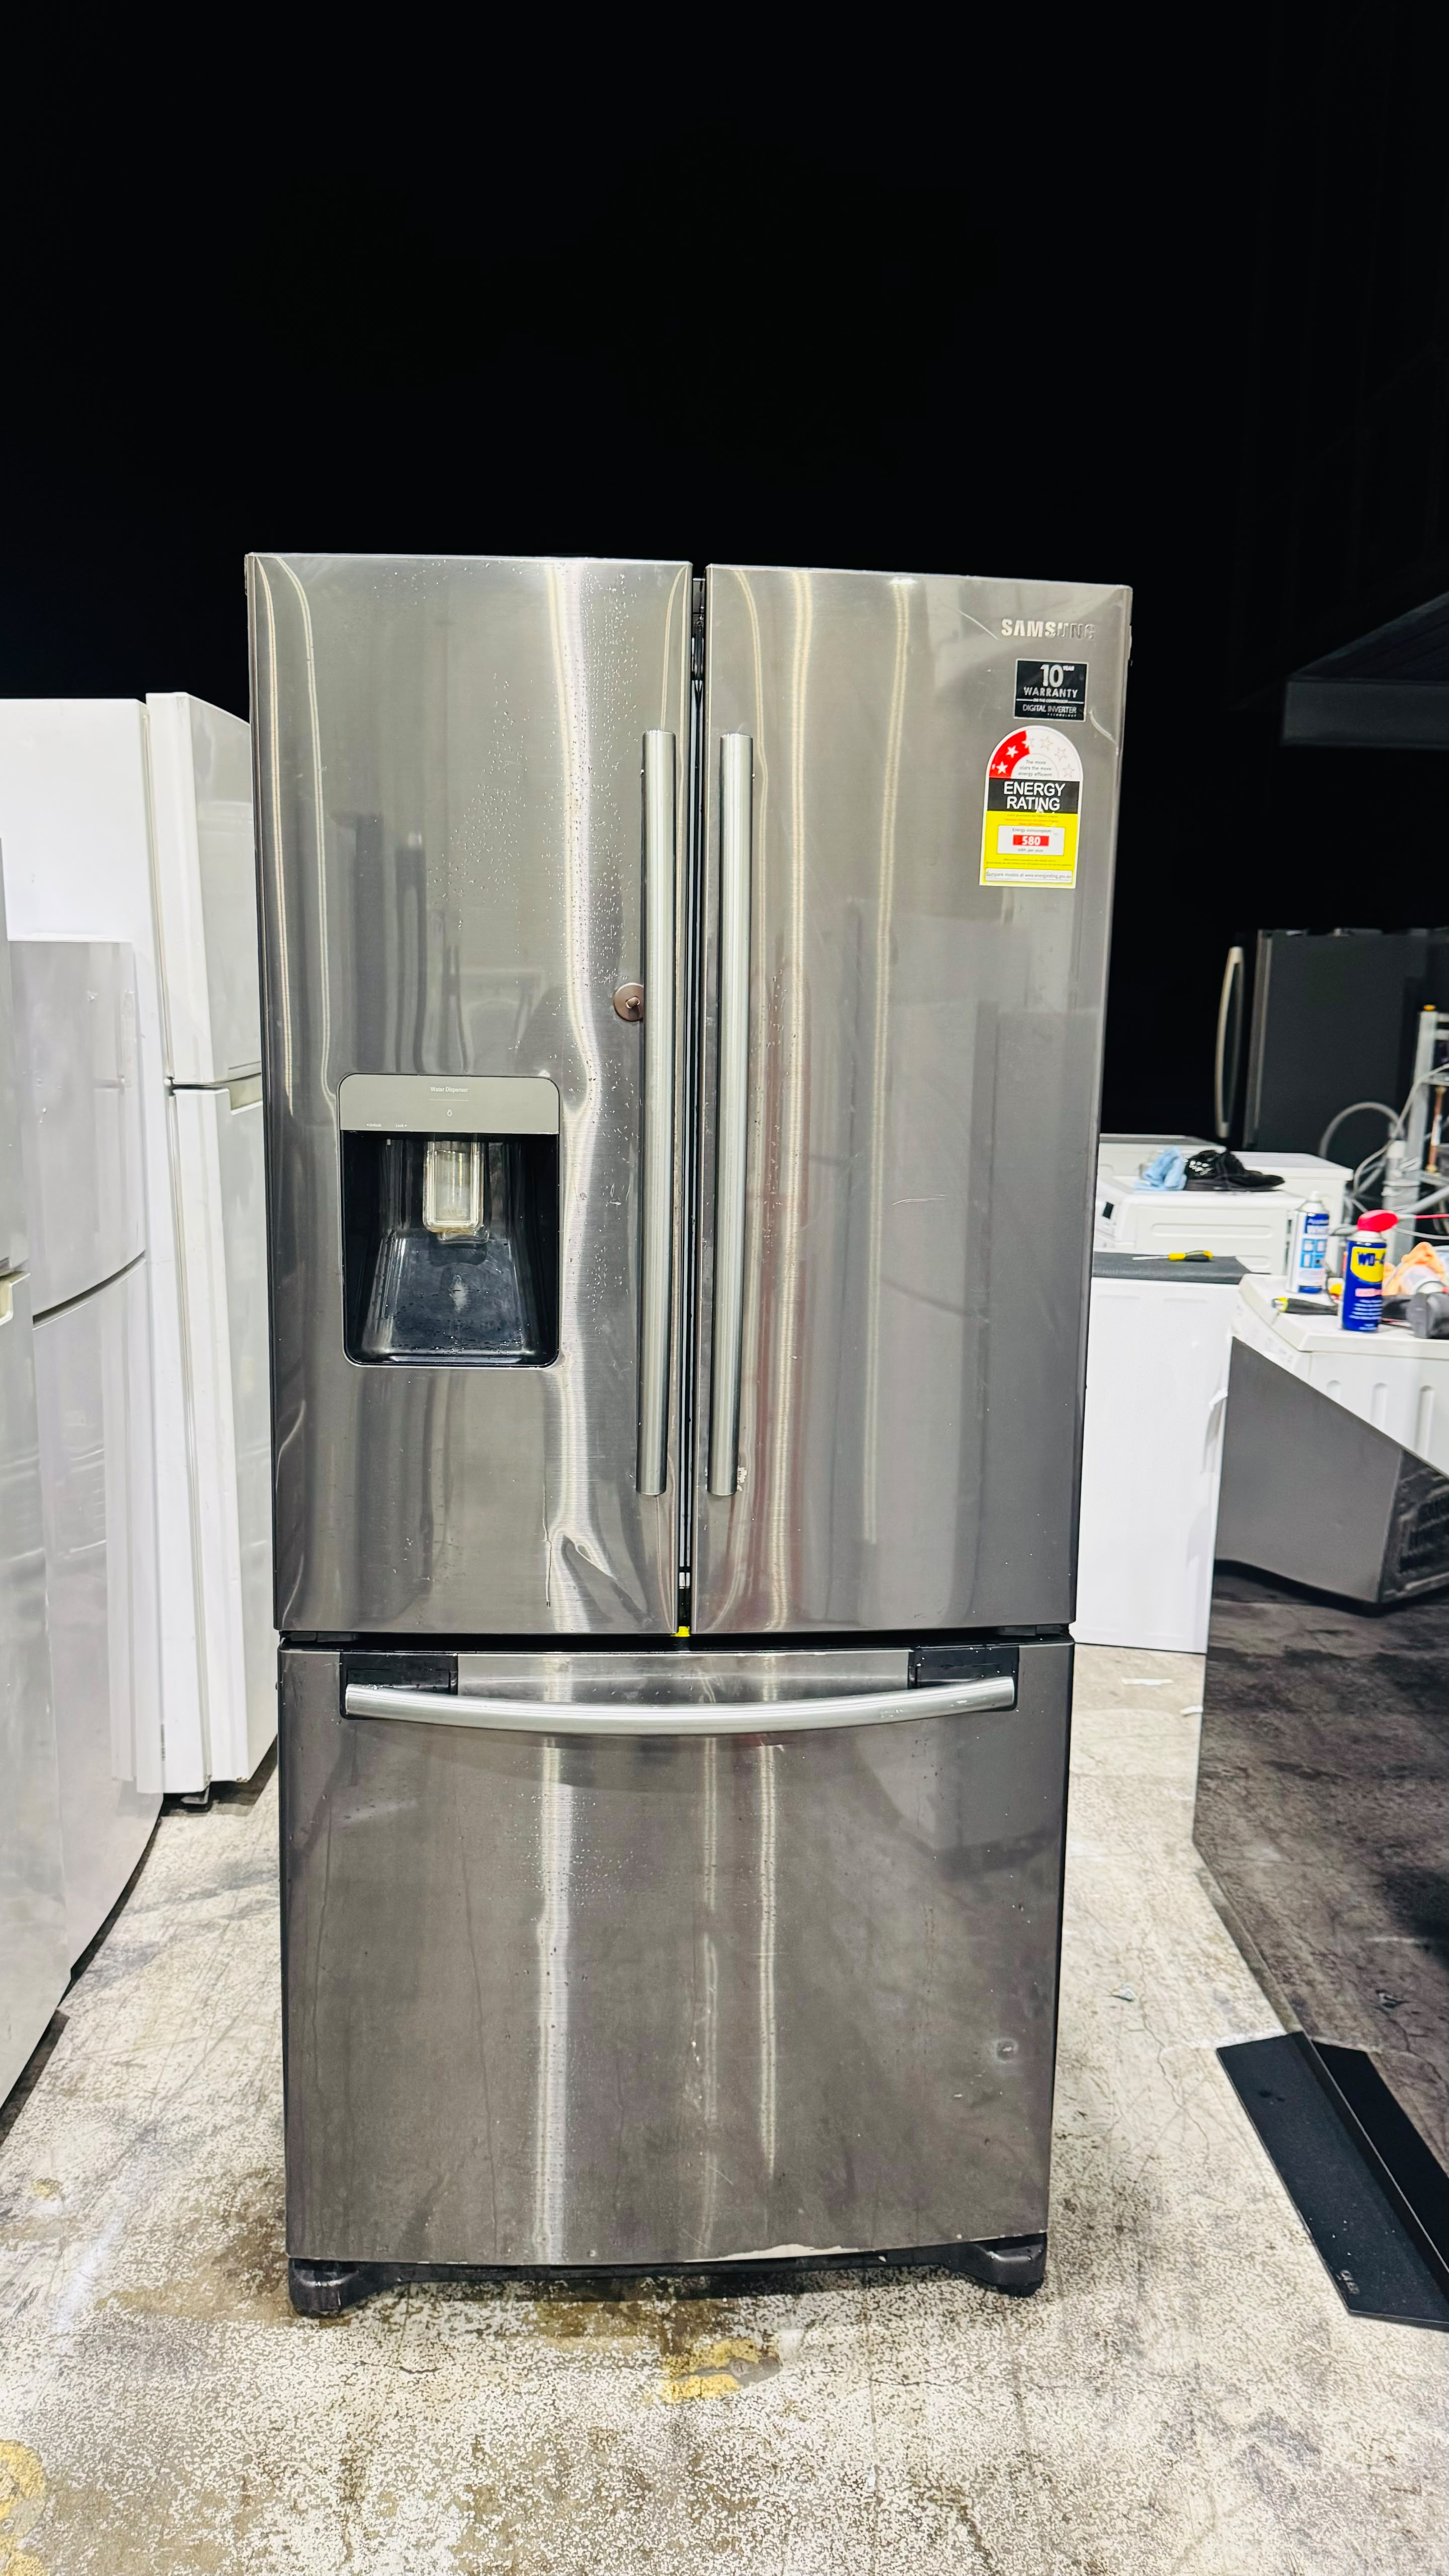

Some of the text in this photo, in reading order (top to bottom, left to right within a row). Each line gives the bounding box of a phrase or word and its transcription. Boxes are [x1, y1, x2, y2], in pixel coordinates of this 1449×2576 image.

[1001, 619, 1095, 639] SAMSUNG
[1040, 664, 1064, 687] 10
[1023, 687, 1078, 698] WARRANTY
[1022, 704, 1046, 712] DIGITAL
[1004, 781, 1066, 796] ENERGY
[1007, 796, 1060, 811] RATING
[1022, 836, 1040, 846] 580
